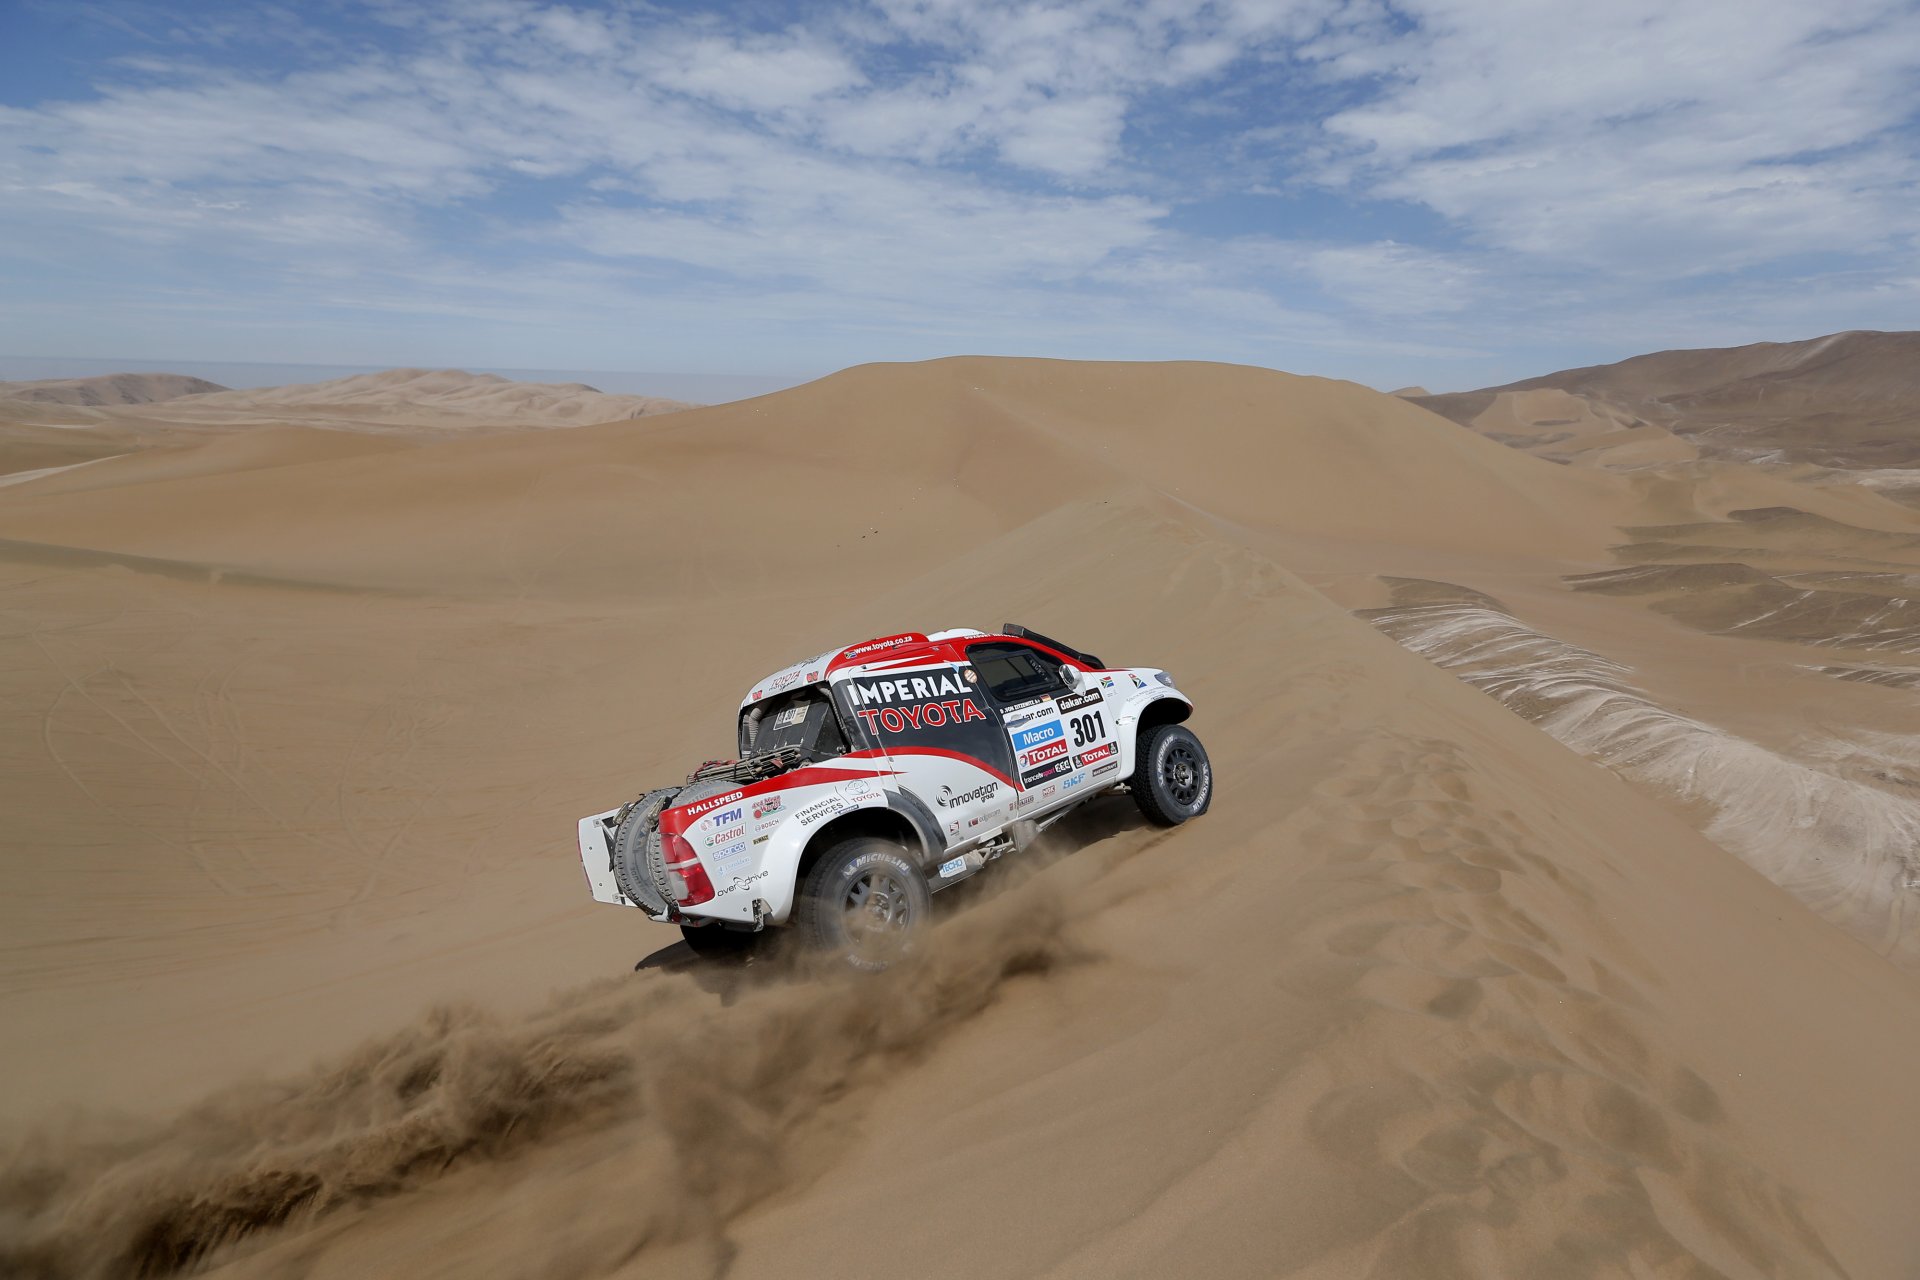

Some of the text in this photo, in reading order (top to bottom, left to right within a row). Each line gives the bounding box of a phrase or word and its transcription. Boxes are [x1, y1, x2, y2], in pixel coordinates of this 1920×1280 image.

[855, 636, 913, 654] www.toyota.co.za
[847, 673, 973, 706] IMPERIAL
[1060, 692, 1100, 710] dakar.com
[857, 698, 986, 735] TOYOTA
[1022, 706, 1054, 721] ar.com
[1023, 728, 1054, 745] Macro
[1070, 711, 1106, 747] 301
[1029, 744, 1067, 762] TOTAL
[1081, 749, 1109, 762] TOTAL
[1157, 735, 1174, 772] MICHELIN
[1062, 772, 1086, 789] SKF
[851, 792, 881, 803] TOYOTA
[949, 781, 999, 809] innovation
[981, 792, 995, 803] group
[1192, 775, 1210, 811] MICHELIN
[687, 791, 743, 816] HALLSPEED
[795, 797, 841, 819] FINANCIAL
[713, 807, 742, 827] TFM
[801, 803, 844, 826] SERVICES
[761, 819, 779, 830] BOSCH
[715, 825, 745, 844] Castrol
[714, 843, 745, 859] sparco
[856, 853, 909, 874] MICHELIN
